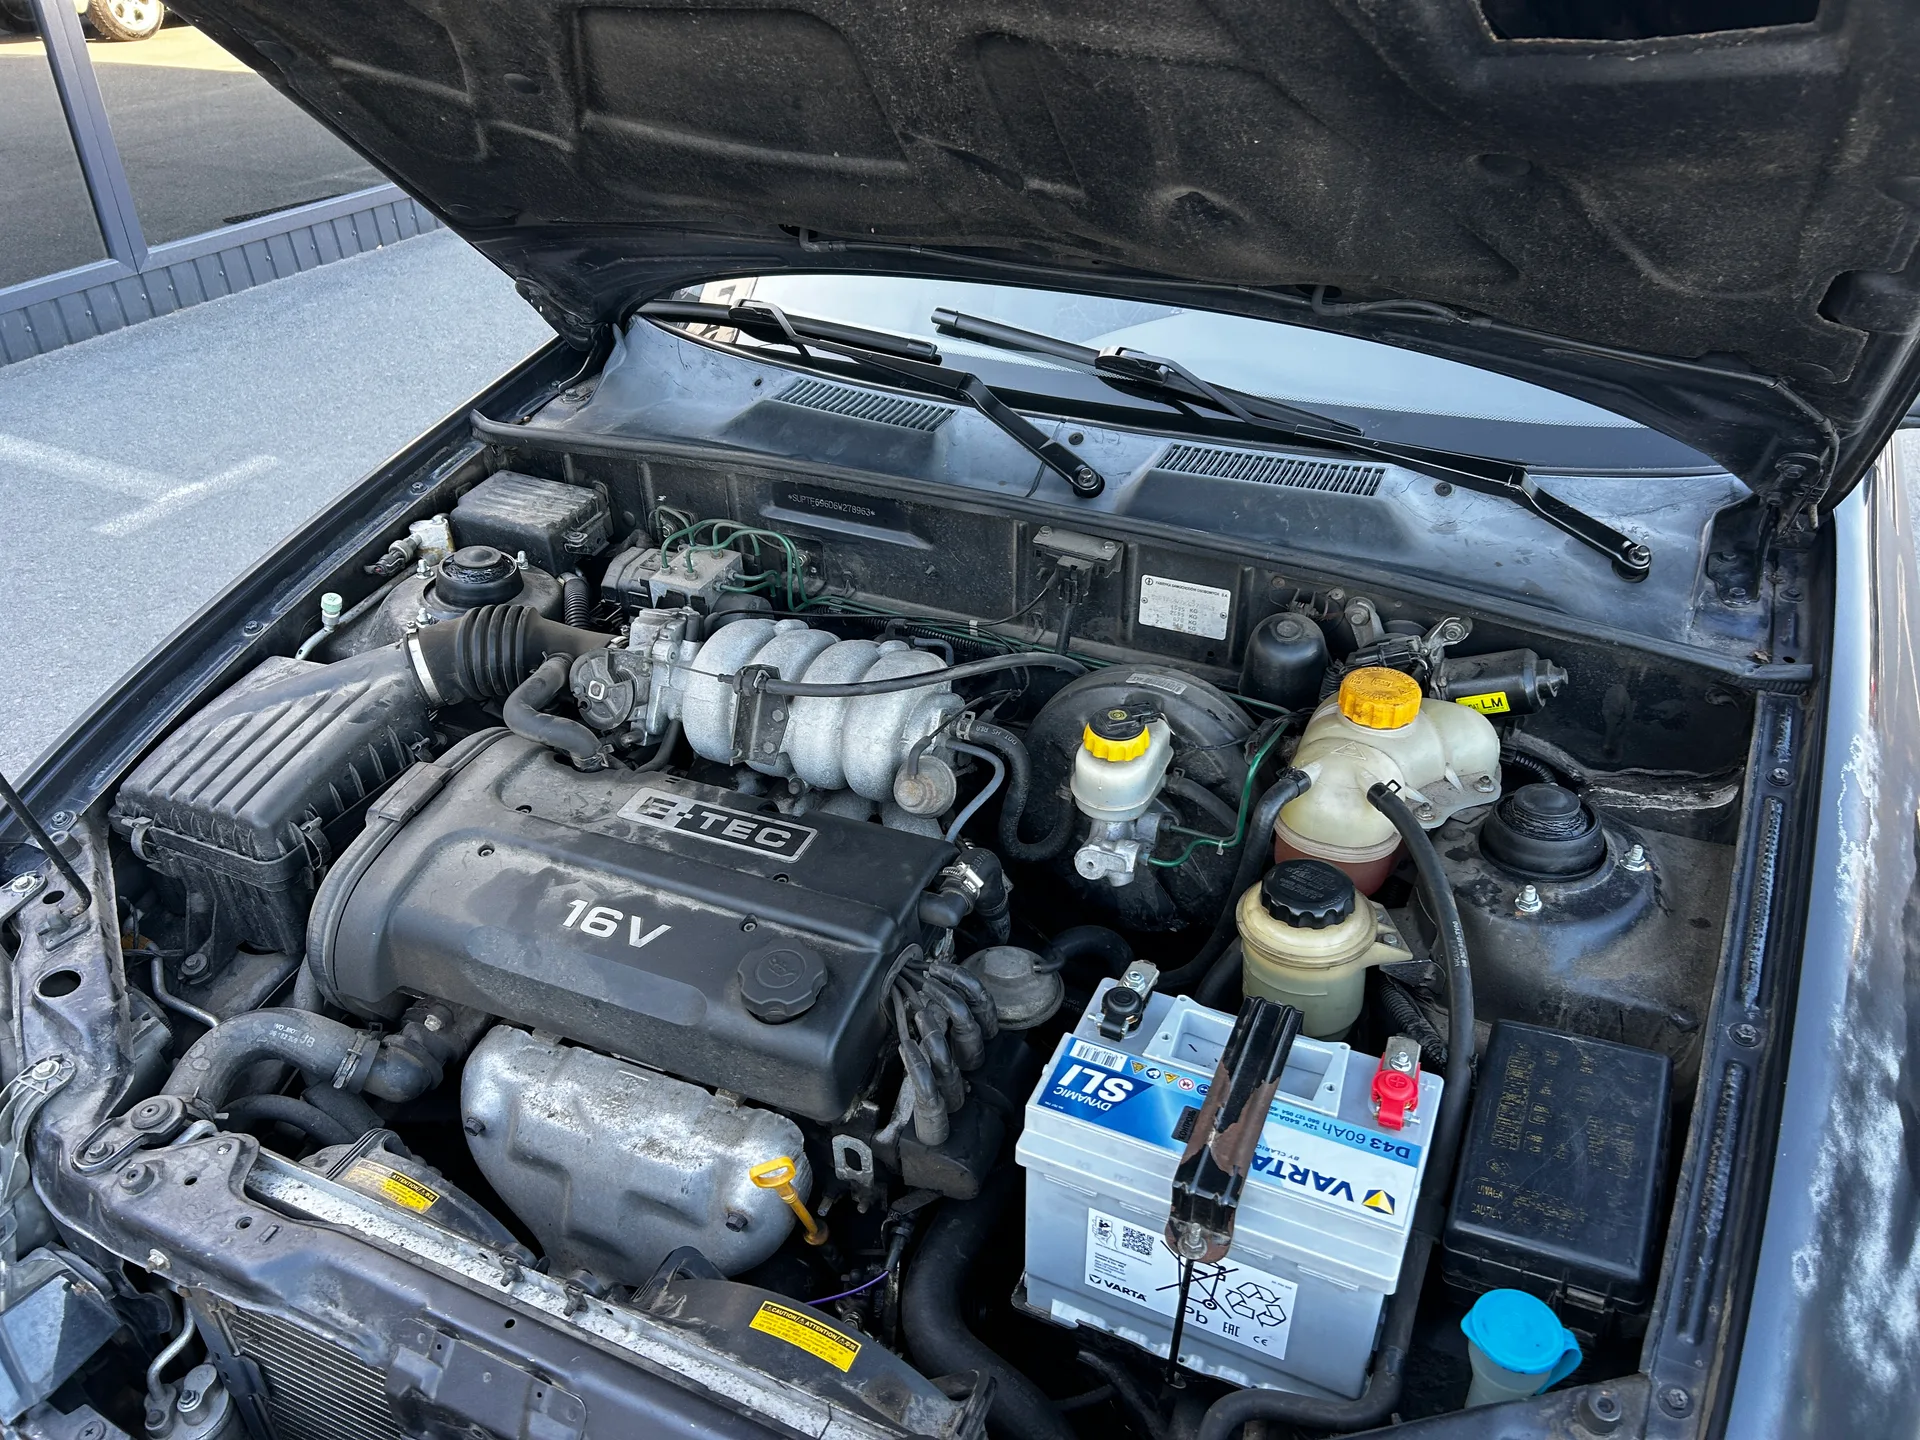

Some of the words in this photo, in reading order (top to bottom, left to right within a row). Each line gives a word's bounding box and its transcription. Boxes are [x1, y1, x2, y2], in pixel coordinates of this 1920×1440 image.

[1481, 697, 1503, 708] LM
[635, 796, 792, 848] E-TEC
[1058, 1064, 1134, 1102] SLI
[1053, 1086, 1112, 1112] DYNAMIC
[1302, 1122, 1318, 1131] 12V
[1322, 1122, 1366, 1144] 60Ah
[1369, 1138, 1410, 1159] D43
[1251, 1152, 1354, 1202] VARTA
[1104, 1280, 1147, 1302] VARTA
